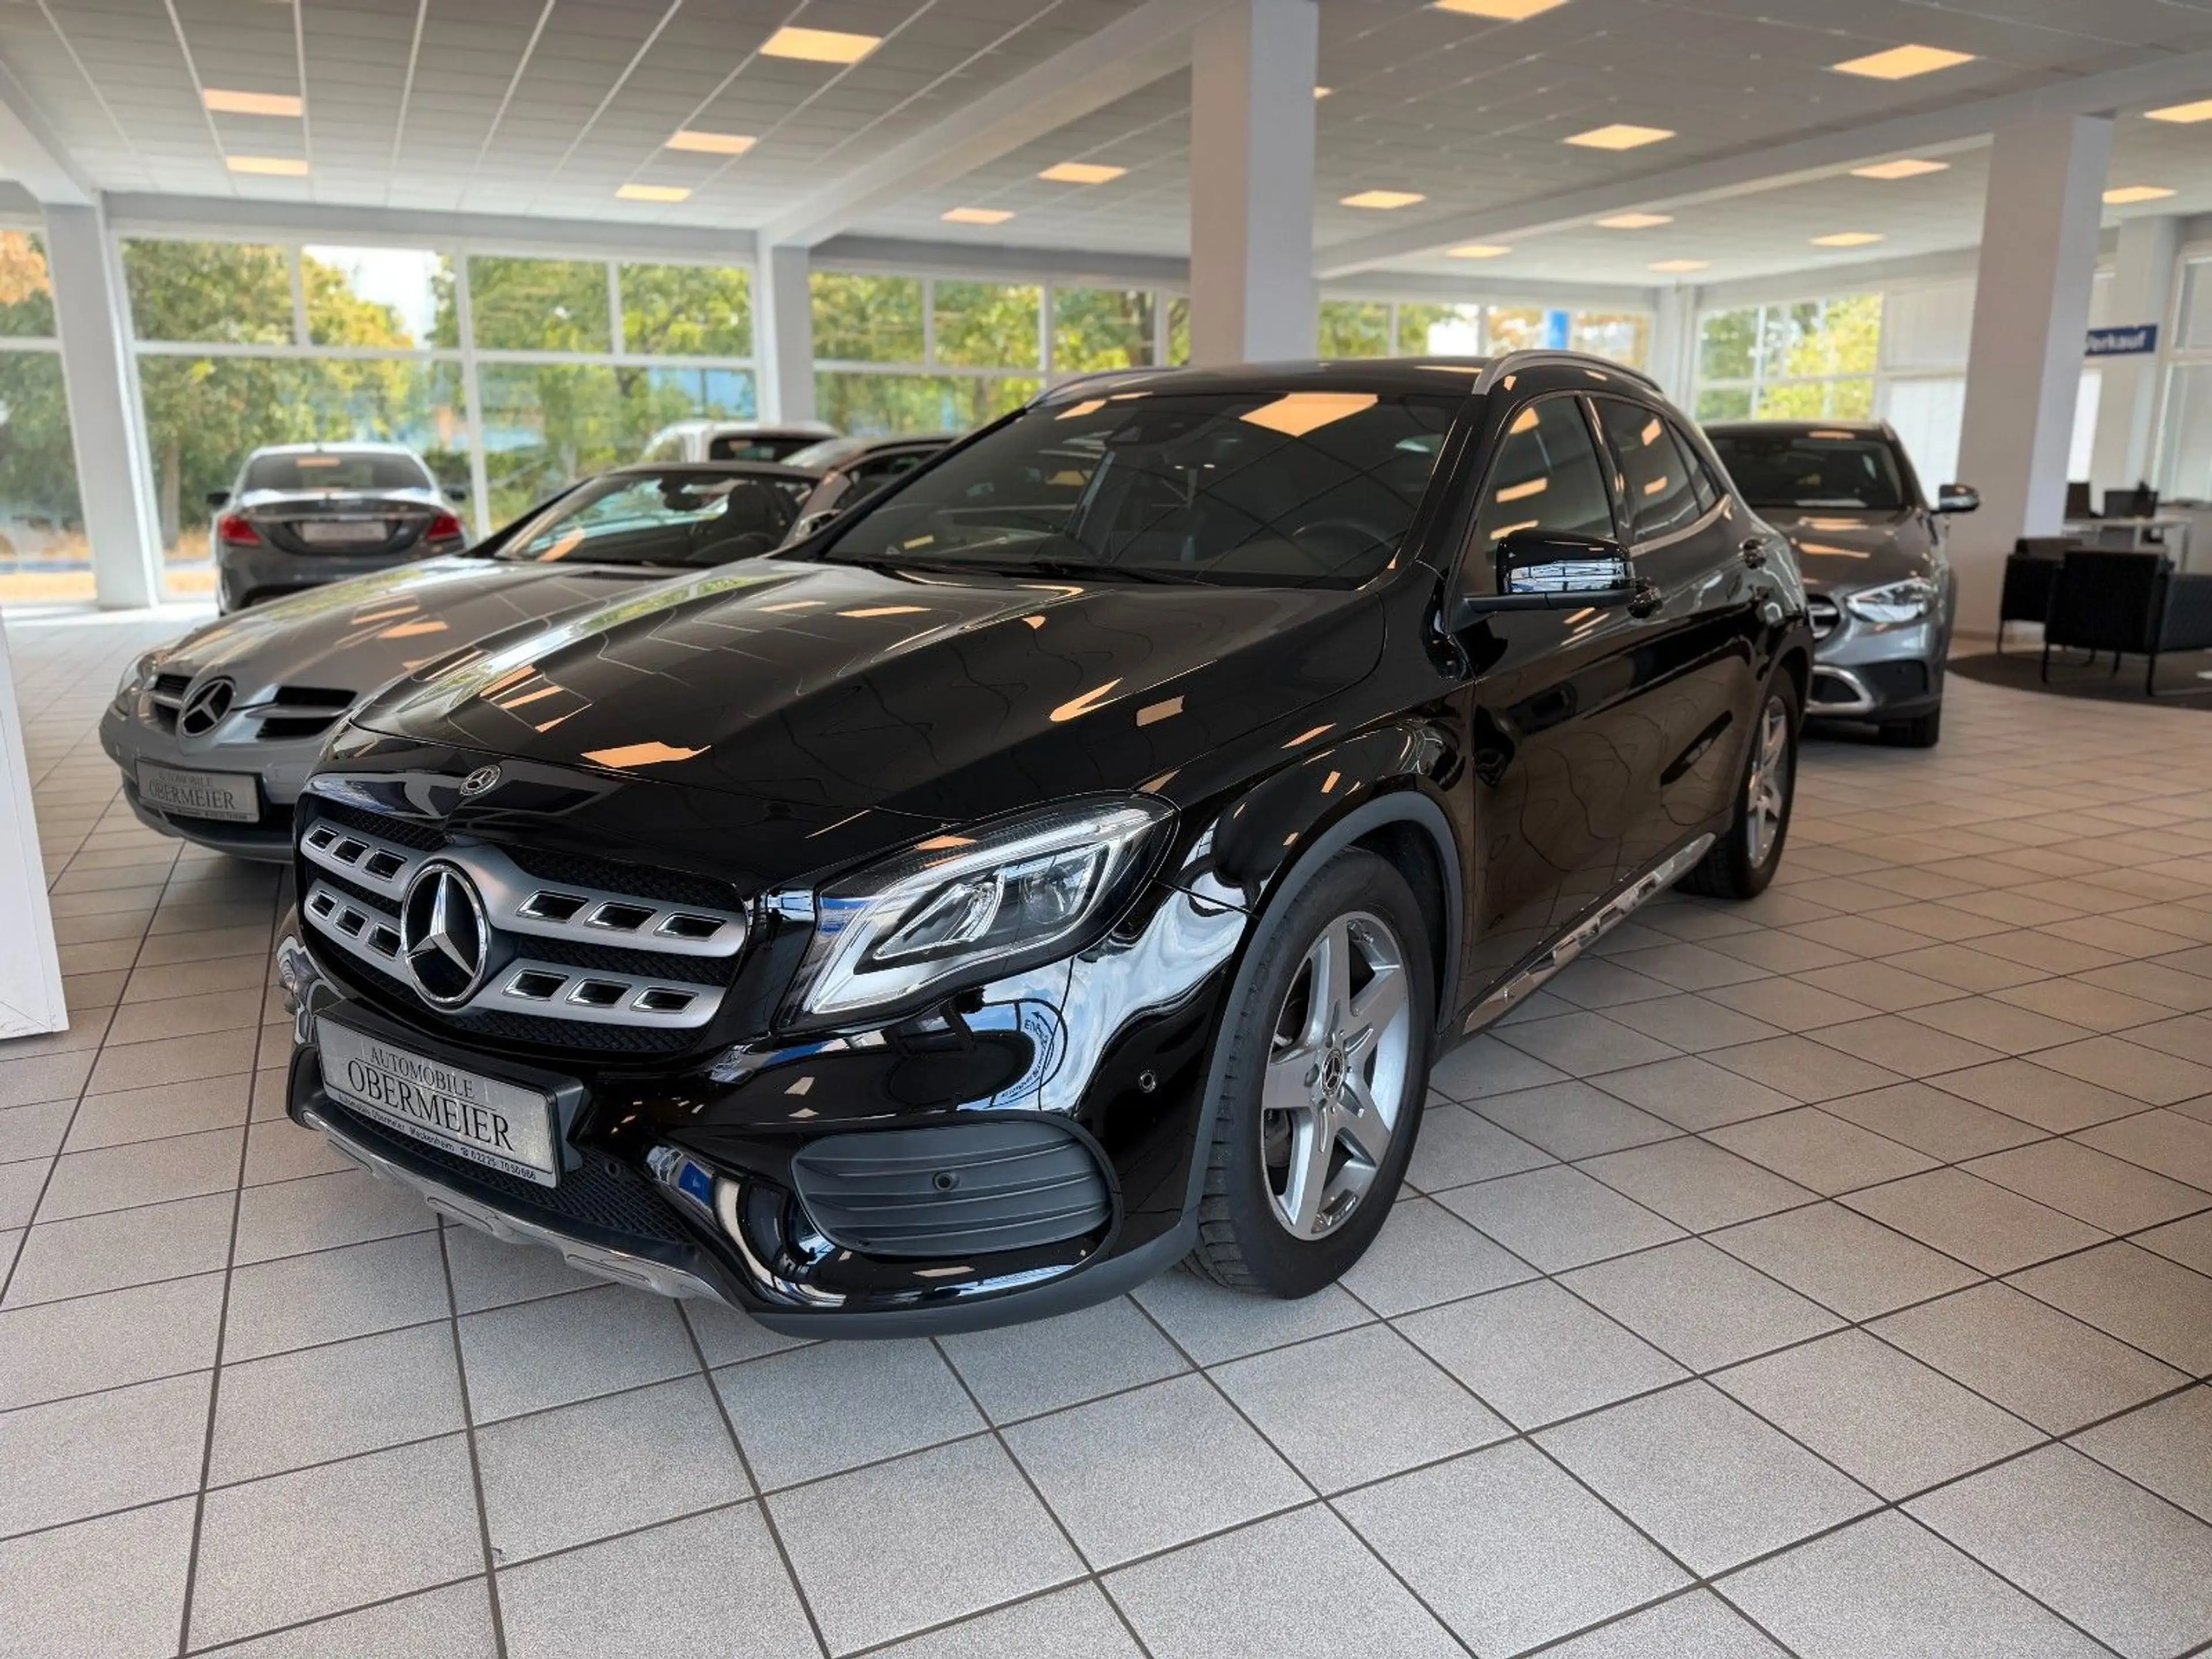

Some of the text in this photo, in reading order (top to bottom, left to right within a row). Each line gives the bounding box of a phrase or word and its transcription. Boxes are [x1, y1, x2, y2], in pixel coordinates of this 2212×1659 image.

[149, 779, 235, 809] OBERMEIER
[370, 1047, 475, 1098] AUTOMOBILE
[347, 1059, 515, 1152] OBERMEIER
